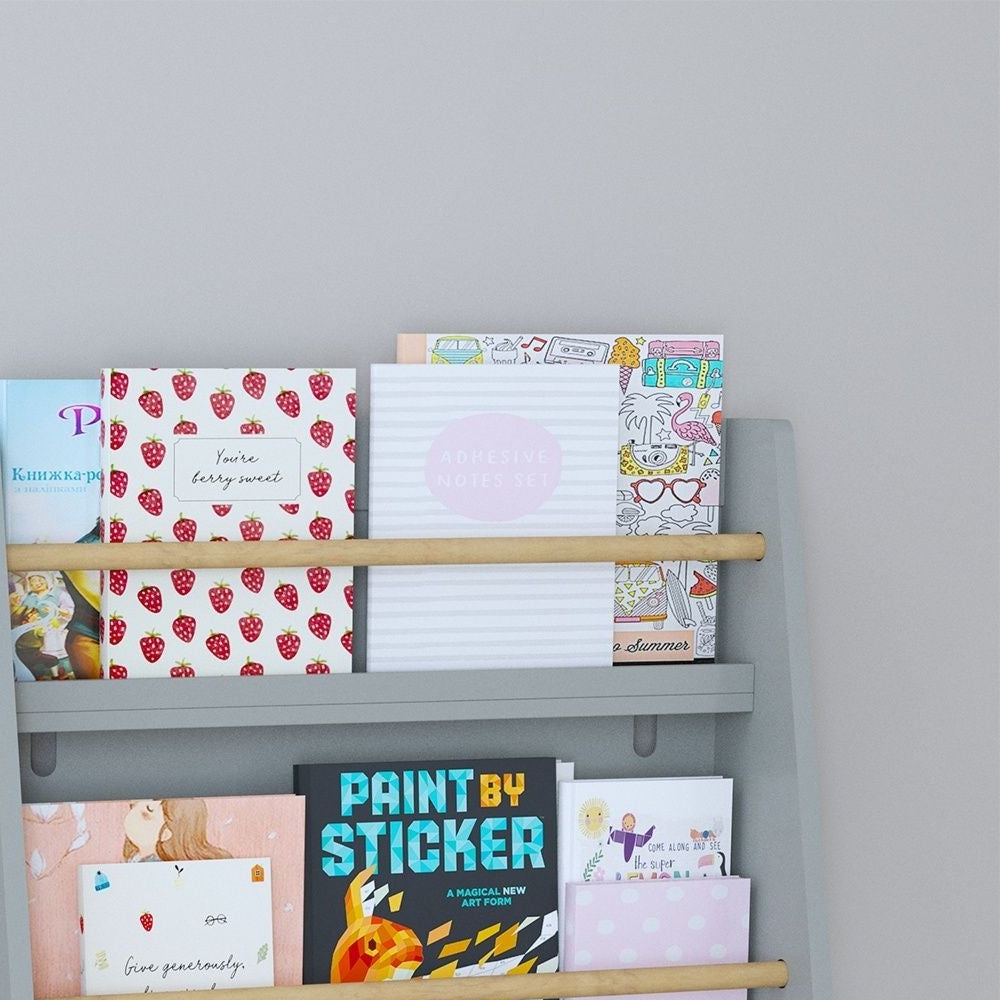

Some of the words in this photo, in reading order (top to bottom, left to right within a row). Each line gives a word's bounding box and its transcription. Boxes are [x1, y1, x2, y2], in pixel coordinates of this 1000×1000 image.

[440, 449, 550, 465] ADHESIVE
[191, 470, 236, 491] berry
[238, 470, 284, 484] sweet
[437, 474, 504, 488] NOTES
[513, 473, 549, 487] SET
[624, 638, 691, 653] Summer
[340, 768, 474, 817] PAINT
[480, 771, 525, 808] BY
[320, 815, 546, 878] STICKER
[647, 843, 665, 853] COME
[668, 842, 690, 852] ALONG
[693, 841, 706, 850] AND
[709, 841, 721, 851] SEE
[634, 855, 648, 870] the
[650, 859, 676, 872] super
[446, 889, 454, 898] A
[456, 887, 500, 897] MAGICAL
[503, 886, 526, 895] NEW
[461, 898, 482, 908] ART
[483, 897, 512, 906] FORM
[124, 955, 159, 976] Give
